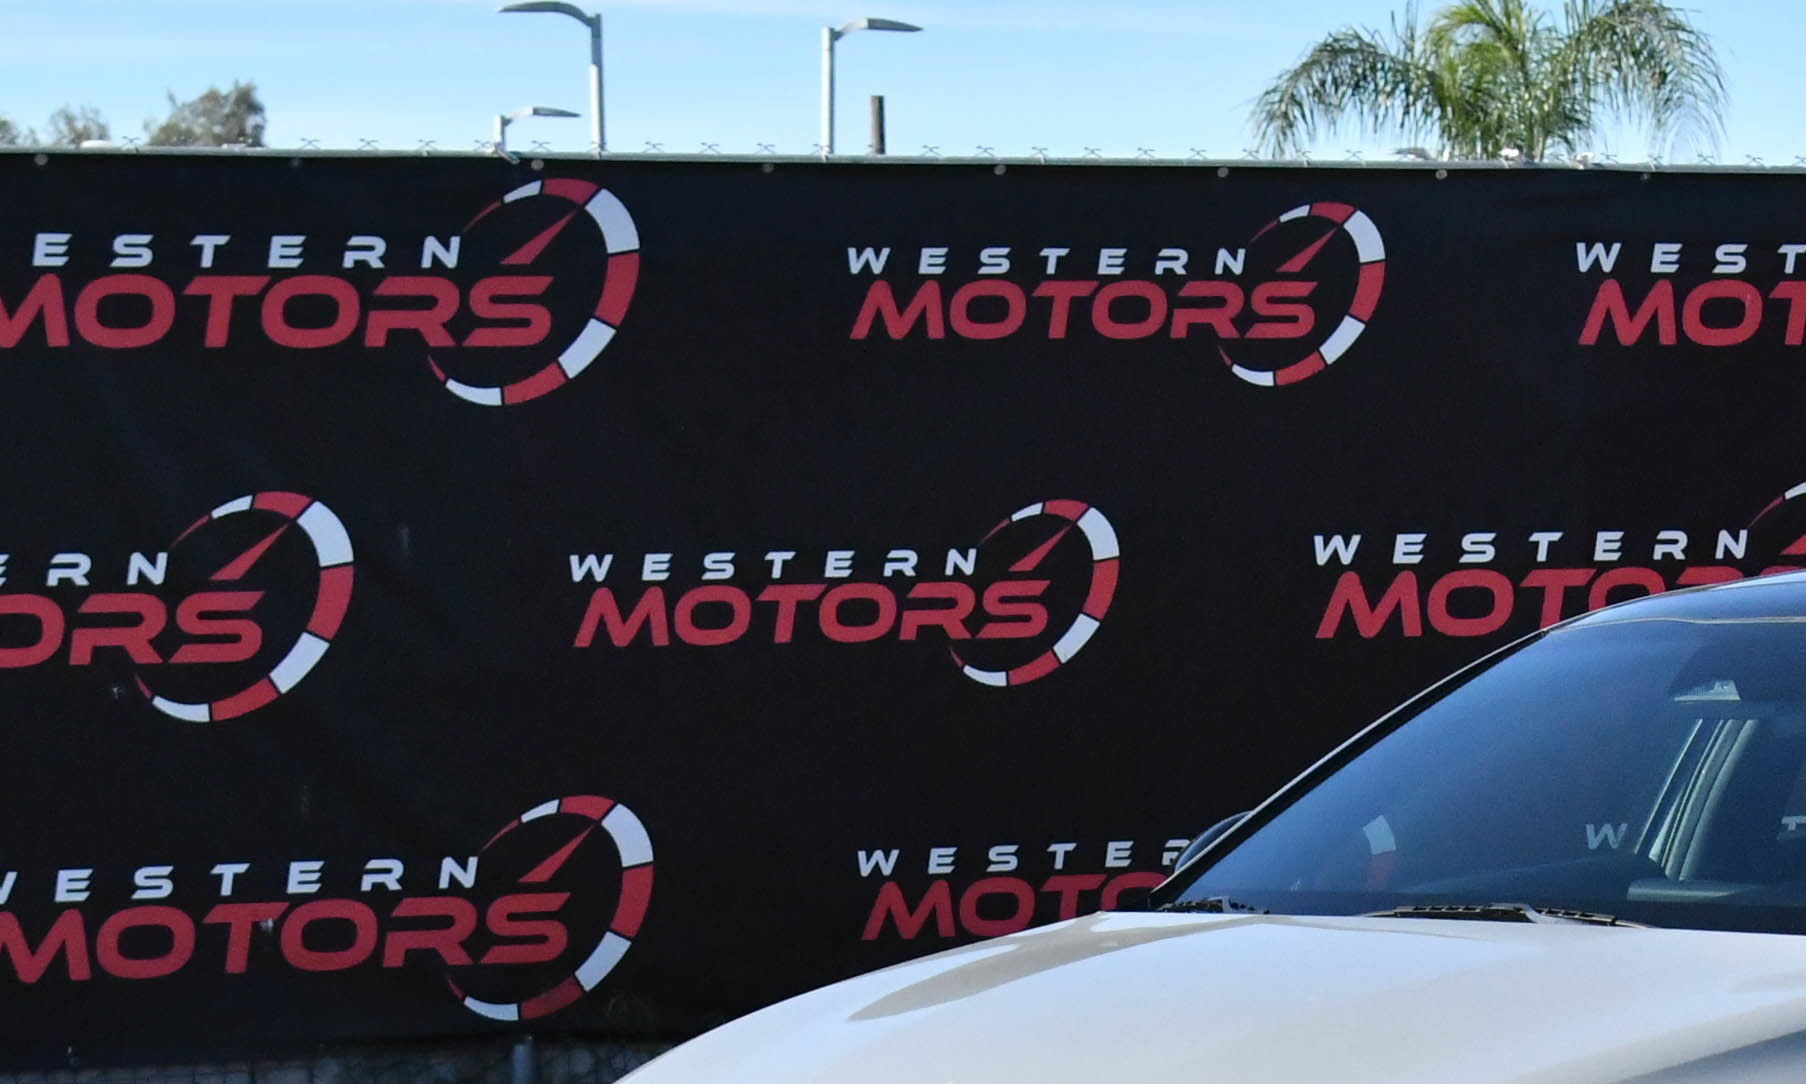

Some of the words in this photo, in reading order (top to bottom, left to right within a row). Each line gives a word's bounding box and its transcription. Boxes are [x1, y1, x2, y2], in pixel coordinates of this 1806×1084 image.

[33, 233, 462, 268] ESTERN
[846, 246, 1247, 276] WESTERN
[848, 279, 1319, 340] MOTORS
[1313, 529, 1748, 566] WESTERN
[569, 549, 977, 583] WESTERN
[573, 580, 1051, 648] MOTORS
